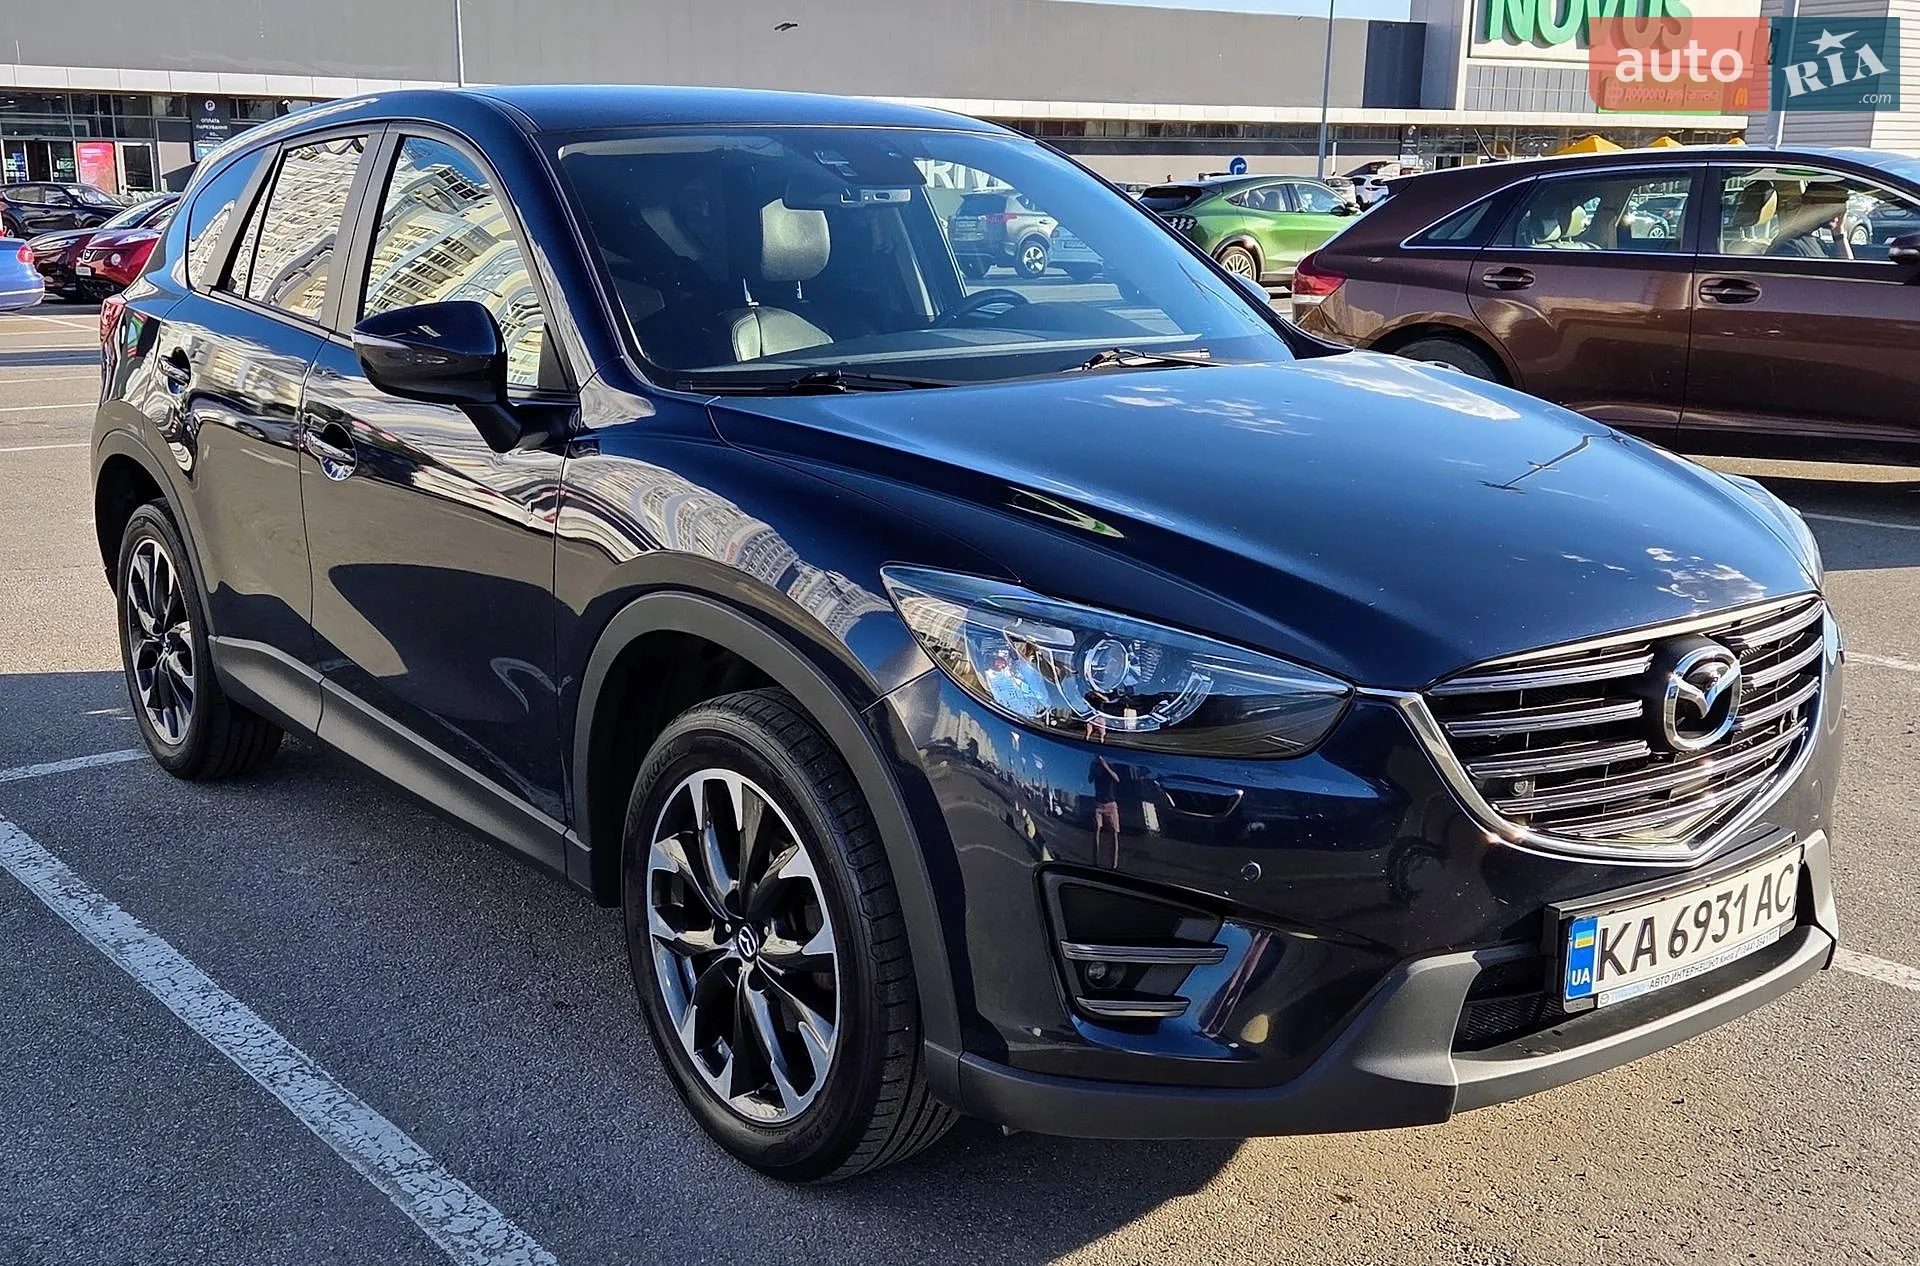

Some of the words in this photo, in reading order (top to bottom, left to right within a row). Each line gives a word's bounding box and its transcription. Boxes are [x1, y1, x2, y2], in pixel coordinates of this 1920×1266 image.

[1624, 84, 1666, 101] доброго
[1665, 88, 1684, 103] дня
[1595, 917, 1657, 981] KA
[1667, 883, 1749, 959] 6931
[1753, 863, 1795, 927] AC
[1571, 970, 1590, 985] UA
